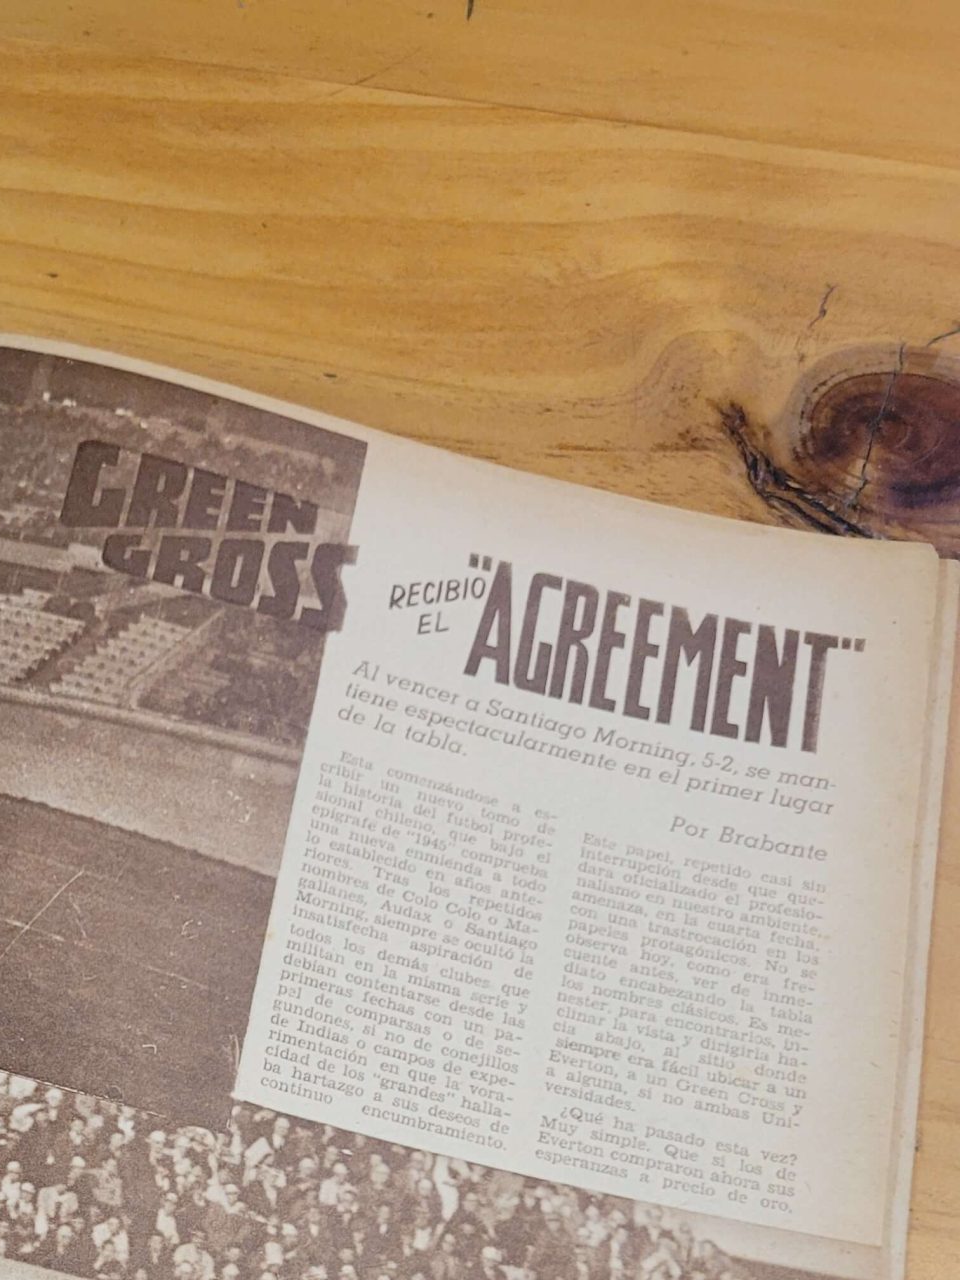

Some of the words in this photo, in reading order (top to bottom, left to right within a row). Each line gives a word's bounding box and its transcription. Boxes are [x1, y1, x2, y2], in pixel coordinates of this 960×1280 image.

[60, 440, 319, 535] GREEN
[389, 576, 486, 609] RECIBIO
[417, 612, 449, 635] EL
[463, 552, 866, 754] "AGREEMENT"
[337, 704, 366, 725] de
[373, 714, 396, 735] la
[405, 725, 468, 757] tabla.
[345, 683, 398, 711] tiene
[404, 703, 617, 771] espectacularmente
[624, 761, 651, 780] en
[659, 770, 679, 785] el
[685, 776, 763, 803] primer
[769, 788, 835, 815] lugar
[352, 660, 380, 681] Al
[386, 673, 459, 705] vencer
[465, 697, 480, 712] a
[485, 699, 586, 739] Santiago
[593, 726, 695, 767] Morning,
[702, 752, 738, 776] 5-2,
[745, 765, 771, 780] se
[777, 771, 837, 790] man-
[670, 816, 709, 839] Por
[718, 825, 829, 862] Brabante
[300, 862, 369, 890] nombres
[376, 882, 396, 898] de
[401, 889, 439, 910] Colo
[445, 901, 482, 921] Colo
[487, 915, 499, 926] o
[505, 917, 539, 935] Ma-
[379, 899, 432, 924] Audax
[443, 918, 454, 929] o
[464, 921, 538, 953] Santiago
[289, 923, 332, 945] todos
[343, 937, 366, 956] los
[376, 948, 429, 973] demás
[498, 983, 531, 999] que
[292, 903, 389, 942] insatisfecha
[409, 934, 493, 971] aspiración
[513, 965, 534, 981] de
[371, 914, 438, 941] siempre
[441, 934, 460, 946] se
[519, 948, 535, 966] la
[279, 969, 354, 999] primeras
[361, 990, 415, 1016] fechas
[423, 1010, 453, 1027] con
[463, 1019, 485, 1035] un
[493, 1027, 523, 1042] pa-
[314, 992, 334, 1009] de
[344, 1003, 431, 1036] comparsas
[442, 1031, 453, 1042] o
[464, 1034, 484, 1050] de
[494, 1044, 521, 1057] se-
[344, 972, 441, 1007] contentarse
[448, 999, 495, 1022] desde
[501, 1011, 526, 1030] las
[264, 1044, 311, 1067] cidad
[316, 1057, 336, 1074] de
[342, 1063, 365, 1082] los
[460, 1095, 512, 1118] halla-
[268, 1029, 368, 1067] rimentación
[379, 1061, 400, 1076] en
[407, 1068, 437, 1089] que
[444, 1075, 463, 1092] la
[469, 1084, 514, 1103] vora-
[270, 1012, 289, 1028] de
[296, 1018, 349, 1045] Indias
[356, 1039, 367, 1050] o
[372, 1044, 436, 1069] campos
[442, 1060, 463, 1076] de
[469, 1069, 516, 1087] expe-
[383, 1030, 406, 1045] no
[413, 1037, 433, 1052] de
[440, 1045, 519, 1075] conejillos
[552, 1020, 577, 1036] cia
[663, 1045, 681, 1059] al
[753, 1063, 808, 1084] donde
[553, 1036, 622, 1062] siempre
[626, 1054, 655, 1069] era
[660, 1059, 699, 1078] fácil
[765, 1083, 777, 1095] a
[784, 1086, 807, 1100] un
[260, 1076, 334, 1105] continuo
[360, 1104, 507, 1151] encumbramiento.
[262, 1057, 282, 1075] ba
[290, 1065, 365, 1097] hartazgo
[372, 1091, 383, 1103] a
[391, 1096, 419, 1113] sus
[427, 1104, 481, 1129] deseos
[489, 1119, 510, 1135] de
[545, 1066, 556, 1078] a
[661, 1092, 685, 1106] no
[693, 1099, 750, 1121] ambas
[761, 1111, 800, 1129] Uni-
[626, 1070, 637, 1081] a
[645, 1073, 668, 1087] un
[675, 1078, 729, 1101] Green
[737, 1091, 785, 1112] Cross
[792, 1104, 804, 1117] y
[536, 1130, 604, 1158] Everton
[609, 1150, 705, 1184] compraron
[709, 1170, 761, 1191] ahora
[766, 1183, 796, 1198] sus
[539, 1114, 579, 1137] Muy
[663, 1143, 699, 1162] Que
[738, 1158, 763, 1176] los
[775, 1167, 797, 1182] de
[612, 1115, 635, 1133] ha
[644, 1125, 706, 1148] pasado
[715, 1140, 751, 1158] esta
[759, 1149, 798, 1167] vez?
[534, 1148, 628, 1179] esperanzas
[639, 1172, 650, 1184] a
[661, 1176, 716, 1197] precio
[727, 1188, 749, 1205] de
